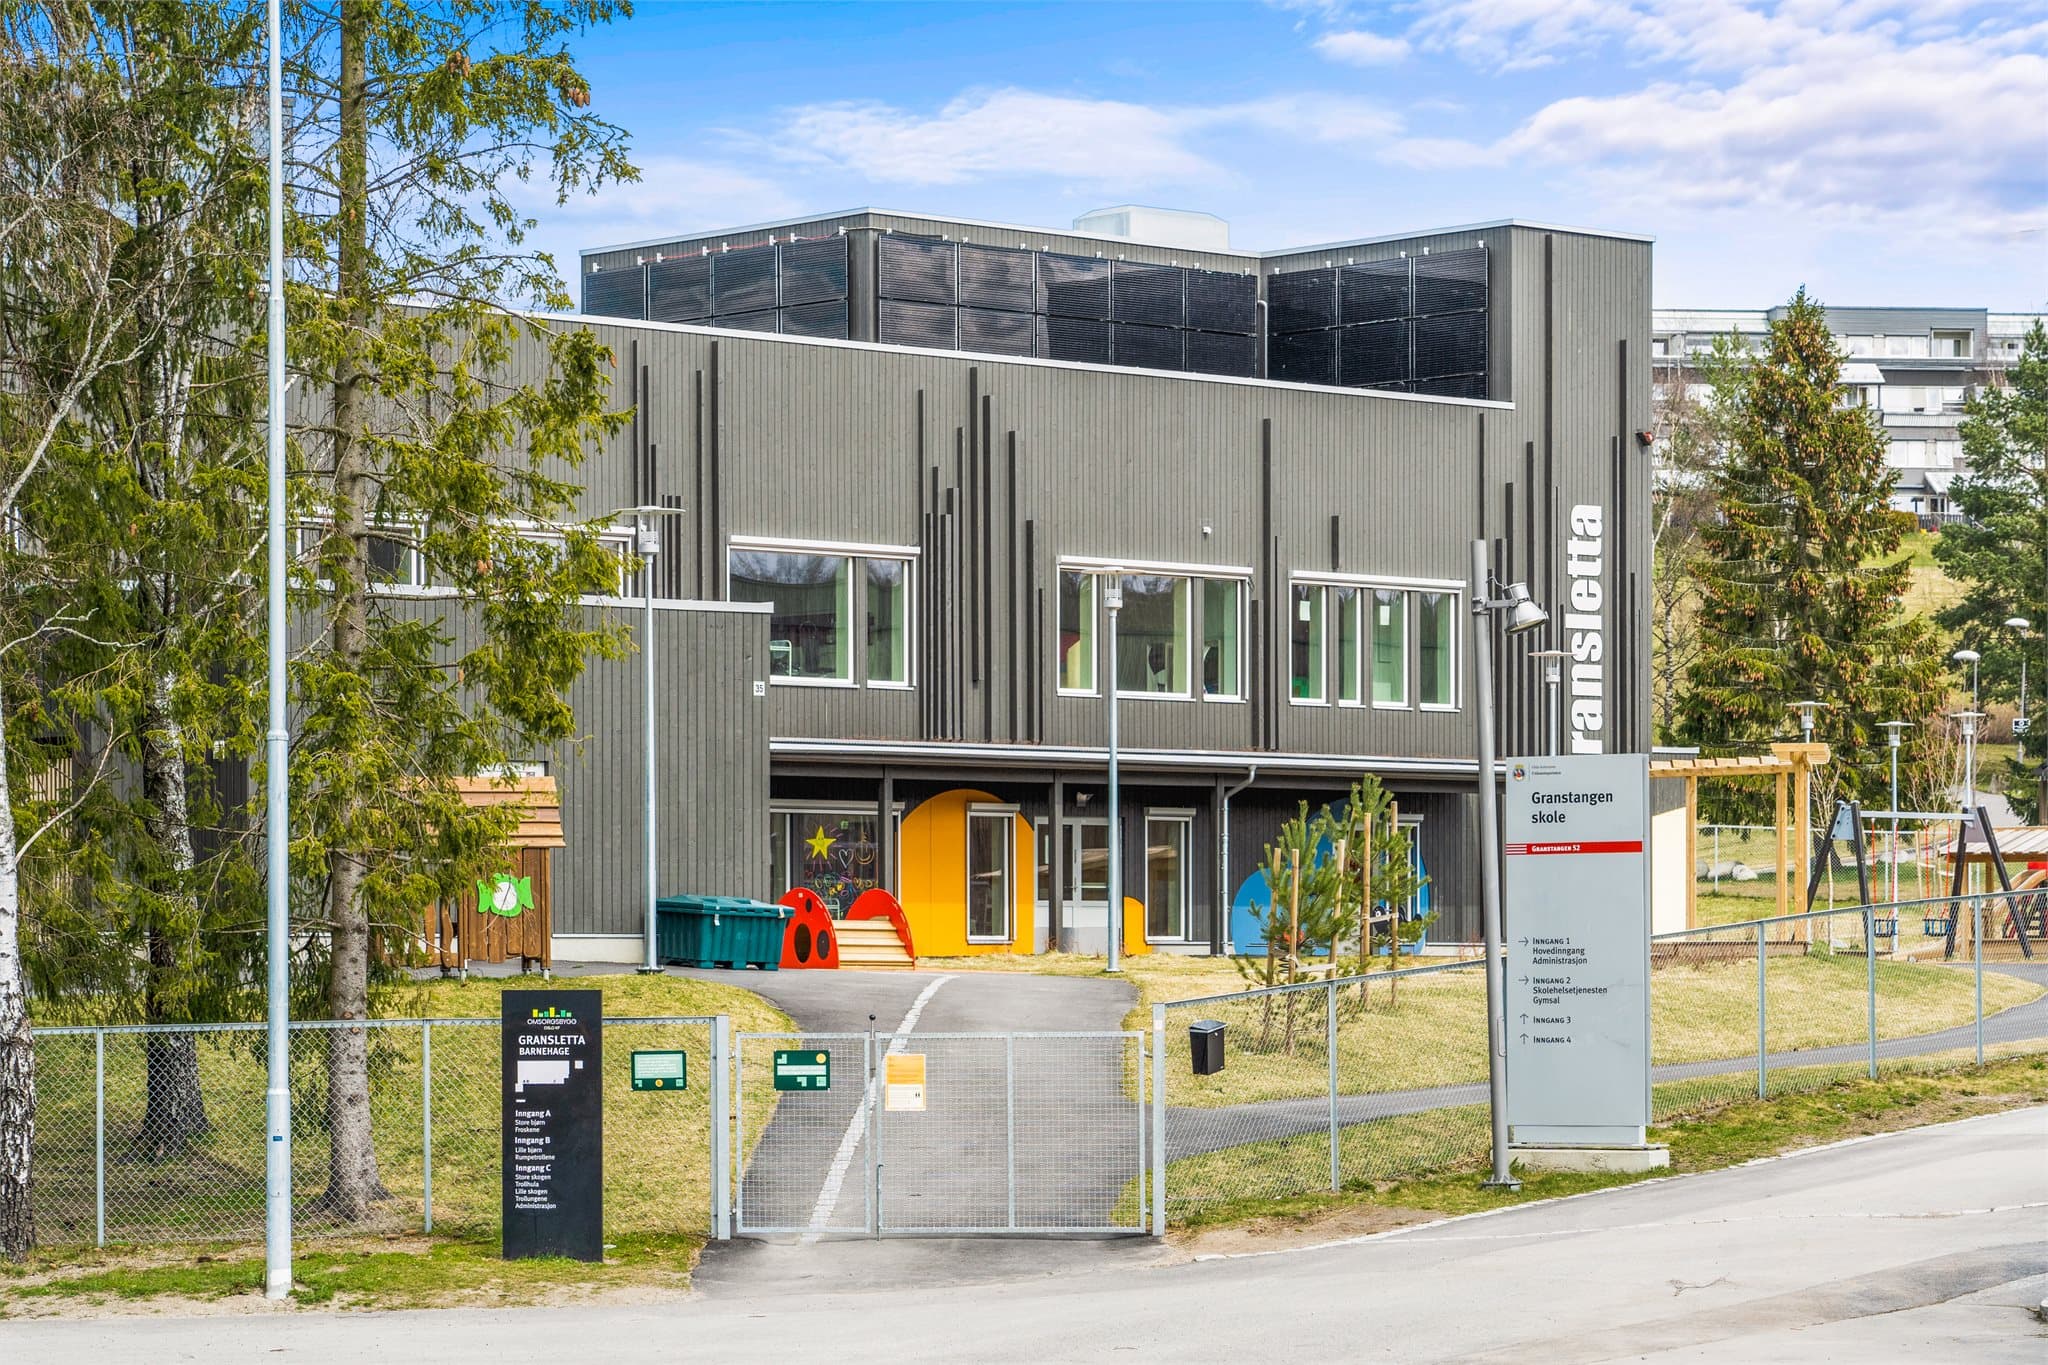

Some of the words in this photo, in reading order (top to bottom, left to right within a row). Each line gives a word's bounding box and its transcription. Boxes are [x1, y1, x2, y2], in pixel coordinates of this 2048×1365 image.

[1565, 505, 1603, 754] ransletta
[755, 684, 764, 693] 35
[1532, 791, 1613, 806] Granstangen
[1531, 811, 1566, 824] skole
[1566, 937, 1570, 945] 1
[1533, 947, 1585, 956] Hovedinngang
[1533, 957, 1588, 966] Administrasjon
[1566, 977, 1571, 985] 2
[1533, 986, 1608, 996] Skolehelsetjenesten
[1533, 996, 1560, 1006] Gymsal
[1566, 1016, 1572, 1024] 3
[518, 1035, 586, 1045] GRANSLETTA
[1566, 1036, 1572, 1044] 4
[519, 1047, 570, 1056] BARNEHAGE
[515, 1110, 545, 1119] Inngang
[515, 1137, 544, 1145] Inngang
[515, 1164, 545, 1173] Inngang
[527, 1188, 548, 1196] skogen
